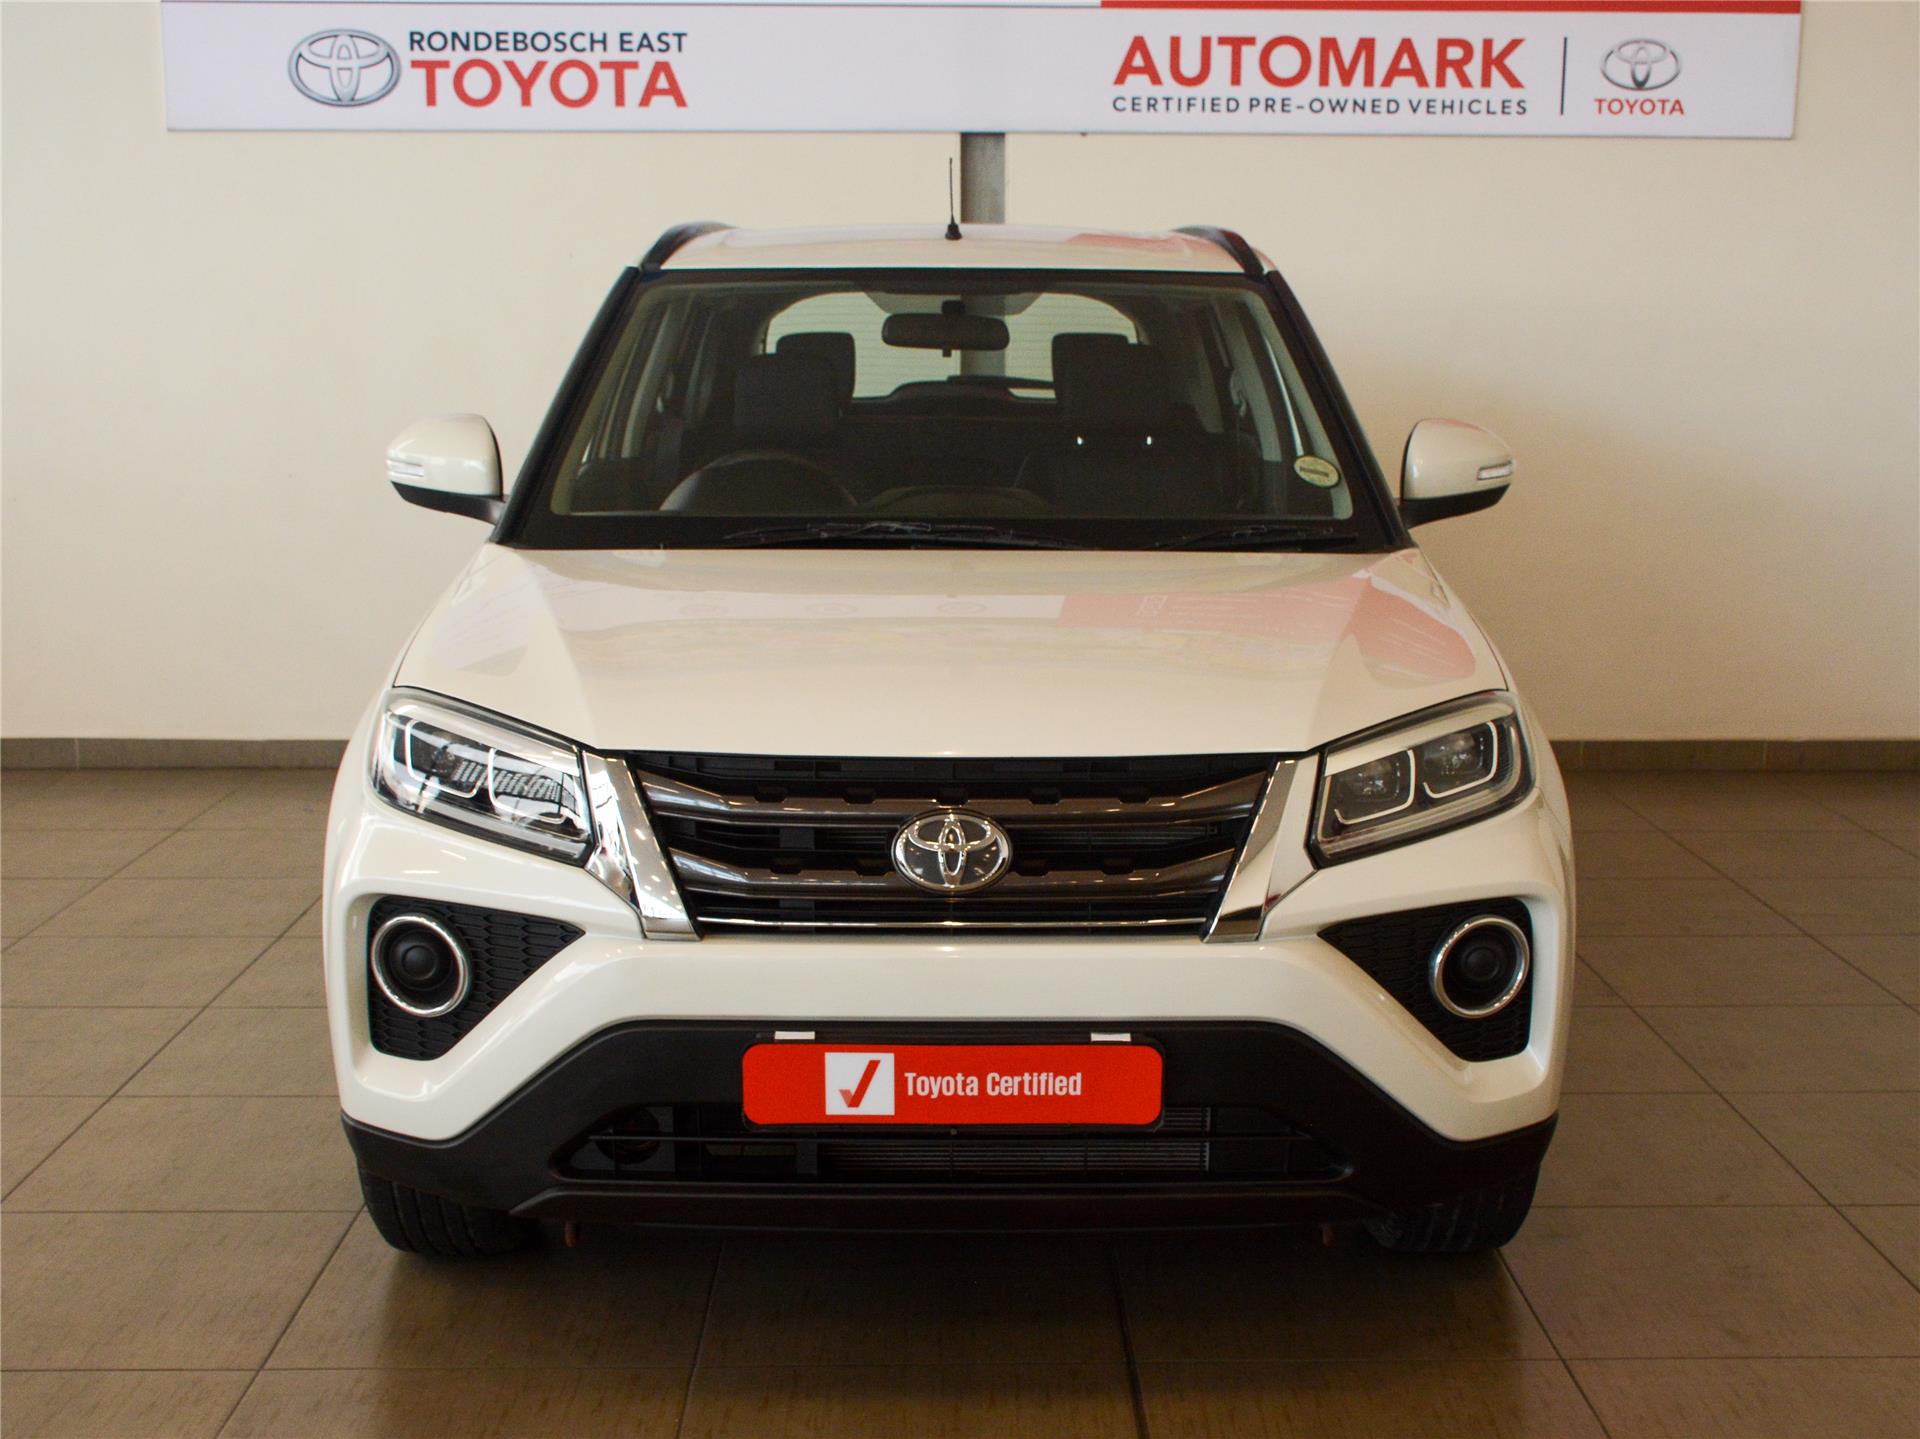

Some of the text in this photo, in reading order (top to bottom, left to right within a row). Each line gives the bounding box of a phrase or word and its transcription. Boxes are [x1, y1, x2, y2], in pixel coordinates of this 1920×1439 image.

[409, 30, 689, 53] RONDEBOSCH EAST
[1113, 35, 1524, 89] AUTOMARK
[410, 58, 688, 108] TOYOTA
[1112, 96, 1527, 116] CERTIFIED PRE-OWNED VEHICLES
[1595, 98, 1684, 116] TOYOTA
[904, 1072, 1082, 1099] Toyota Certified
